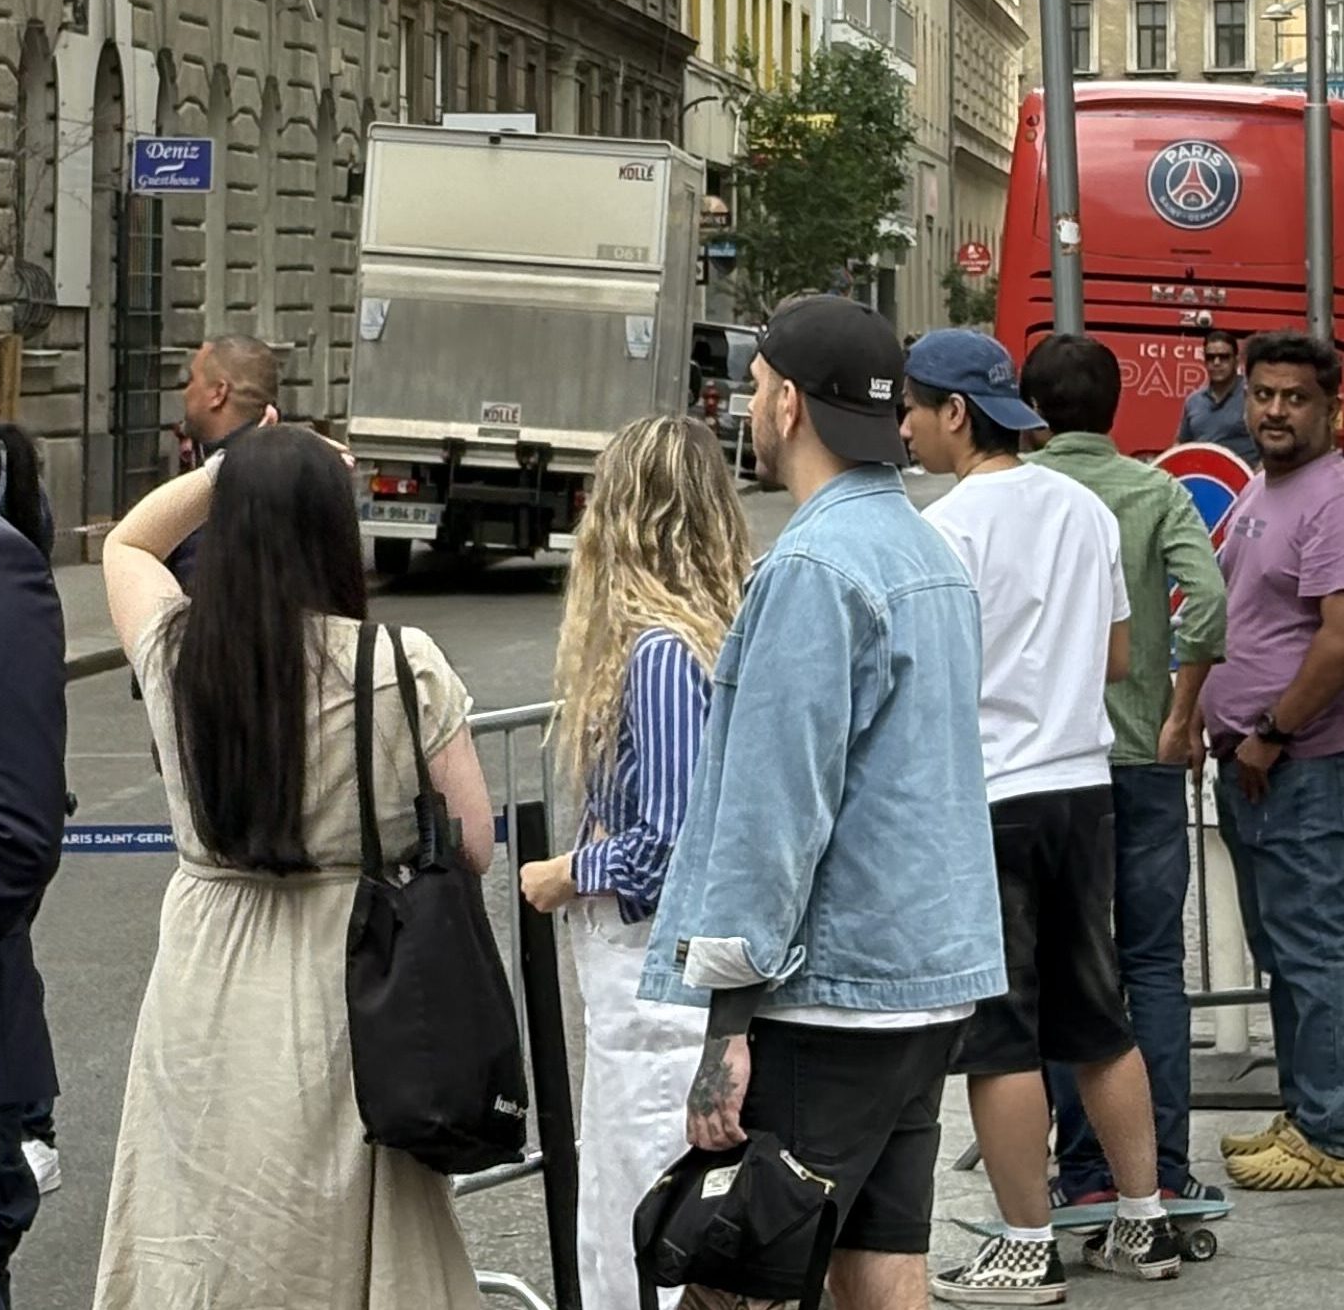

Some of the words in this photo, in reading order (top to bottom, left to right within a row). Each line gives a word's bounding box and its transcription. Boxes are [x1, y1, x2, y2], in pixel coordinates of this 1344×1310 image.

[146, 142, 200, 159] Deniz
[1164, 144, 1223, 167] PARIS
[138, 173, 201, 189] Guesthouse
[1151, 285, 1227, 305] MAN
[1140, 343, 1166, 358] ICI
[1173, 345, 1206, 361] C'E
[1119, 359, 1209, 398] PAR
[483, 405, 520, 424] KOLLÉ
[61, 833, 92, 844] ARIS
[94, 833, 174, 844] SAINT-GERM
